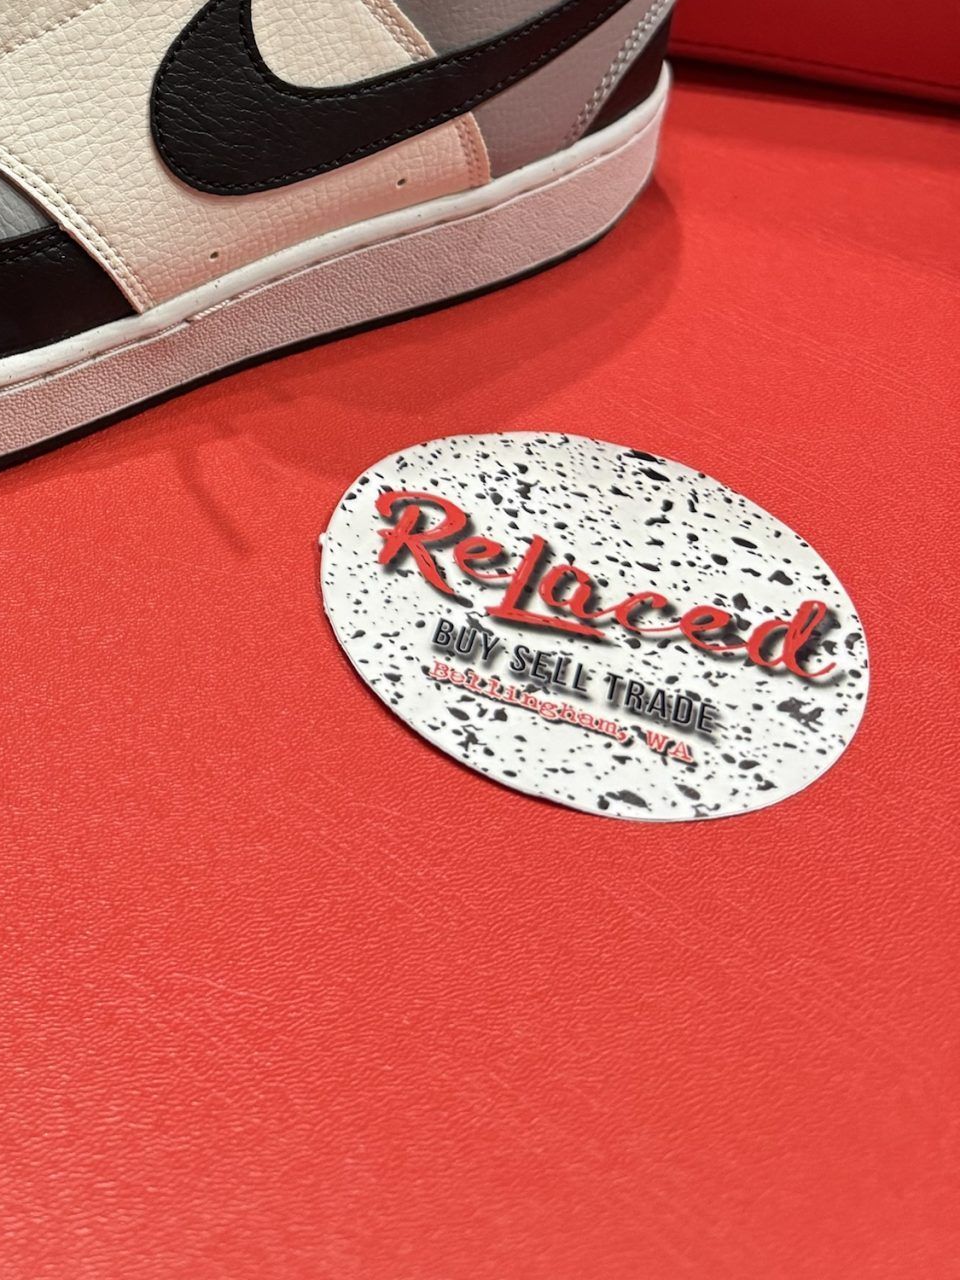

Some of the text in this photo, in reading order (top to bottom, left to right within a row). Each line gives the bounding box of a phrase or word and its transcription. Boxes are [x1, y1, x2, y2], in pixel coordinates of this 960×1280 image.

[374, 491, 836, 678] ReLaced
[429, 659, 693, 762] Bellingham, WA
[432, 618, 718, 735] BUY SELL TRADE
